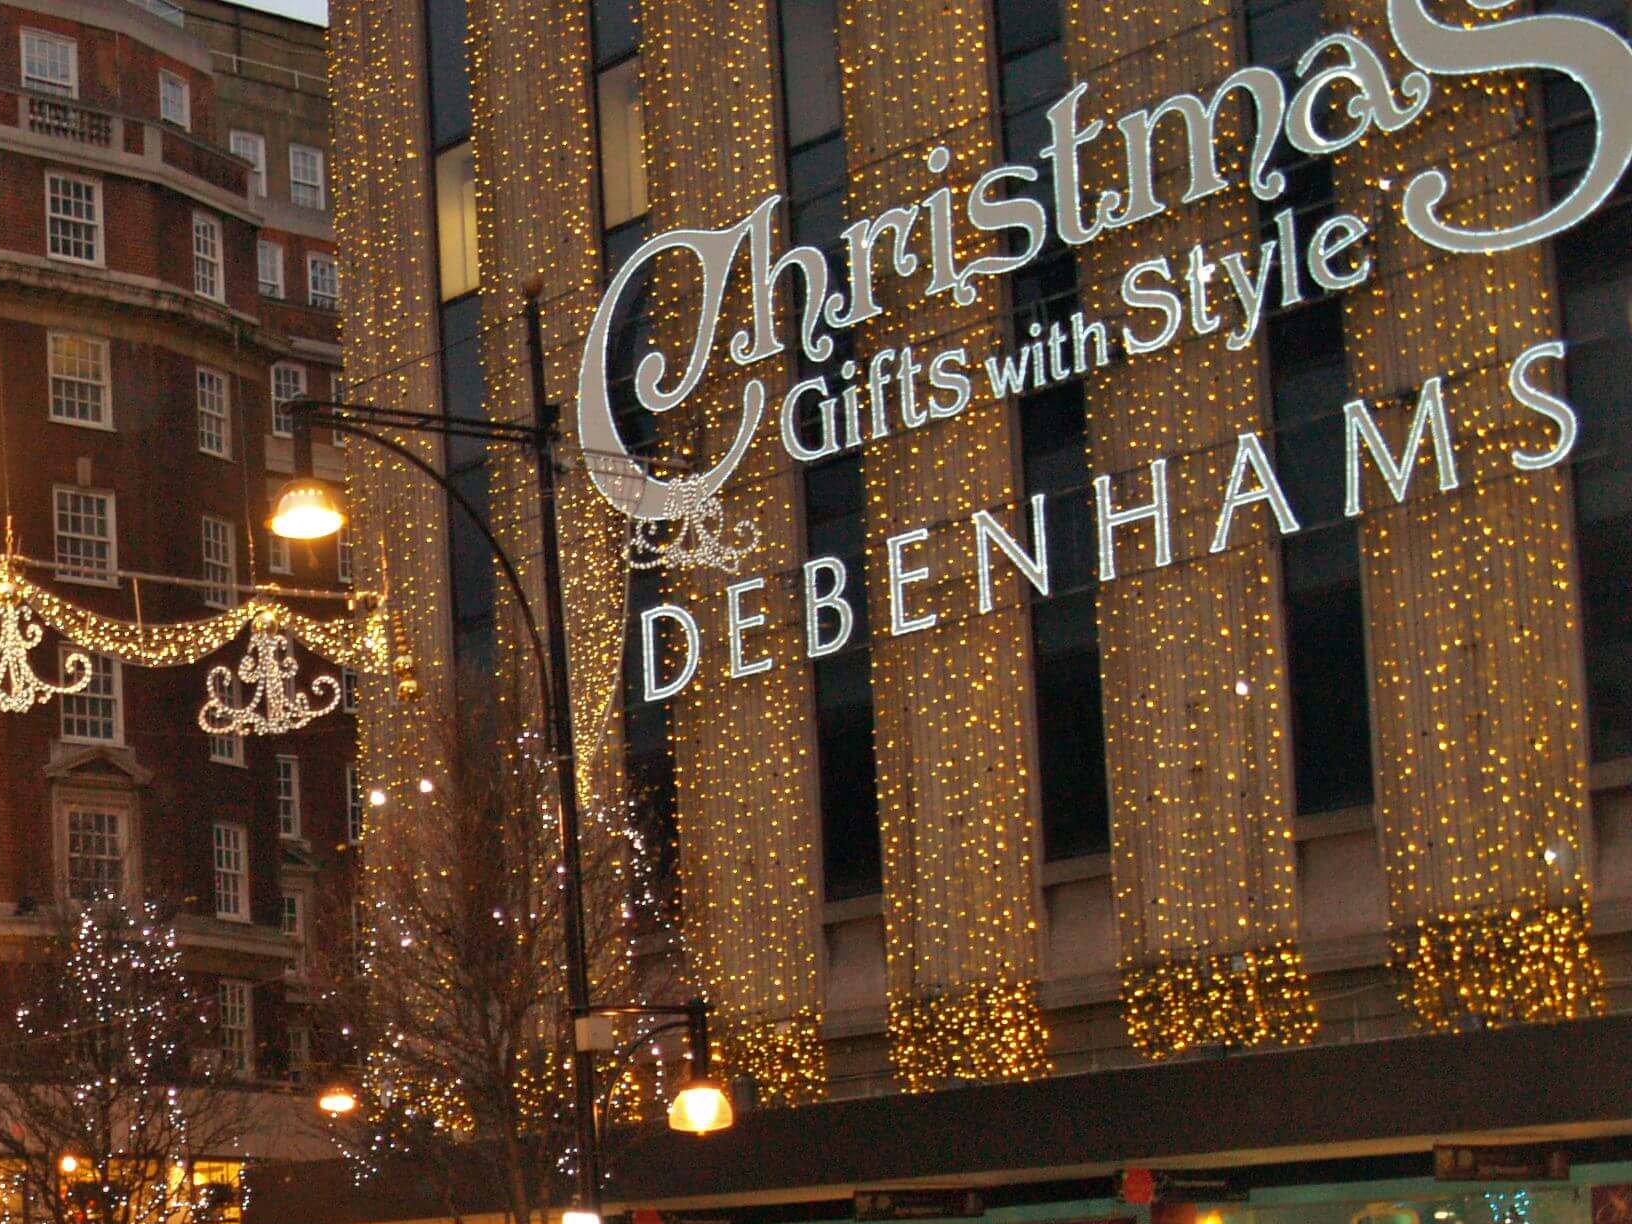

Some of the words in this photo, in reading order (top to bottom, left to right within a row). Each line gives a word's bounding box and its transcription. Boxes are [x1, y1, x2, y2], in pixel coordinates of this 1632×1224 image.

[780, 346, 972, 462] Gifts
[984, 312, 1109, 400] with
[1121, 207, 1370, 354] Style
[640, 340, 1579, 702] DEBENHAMS
